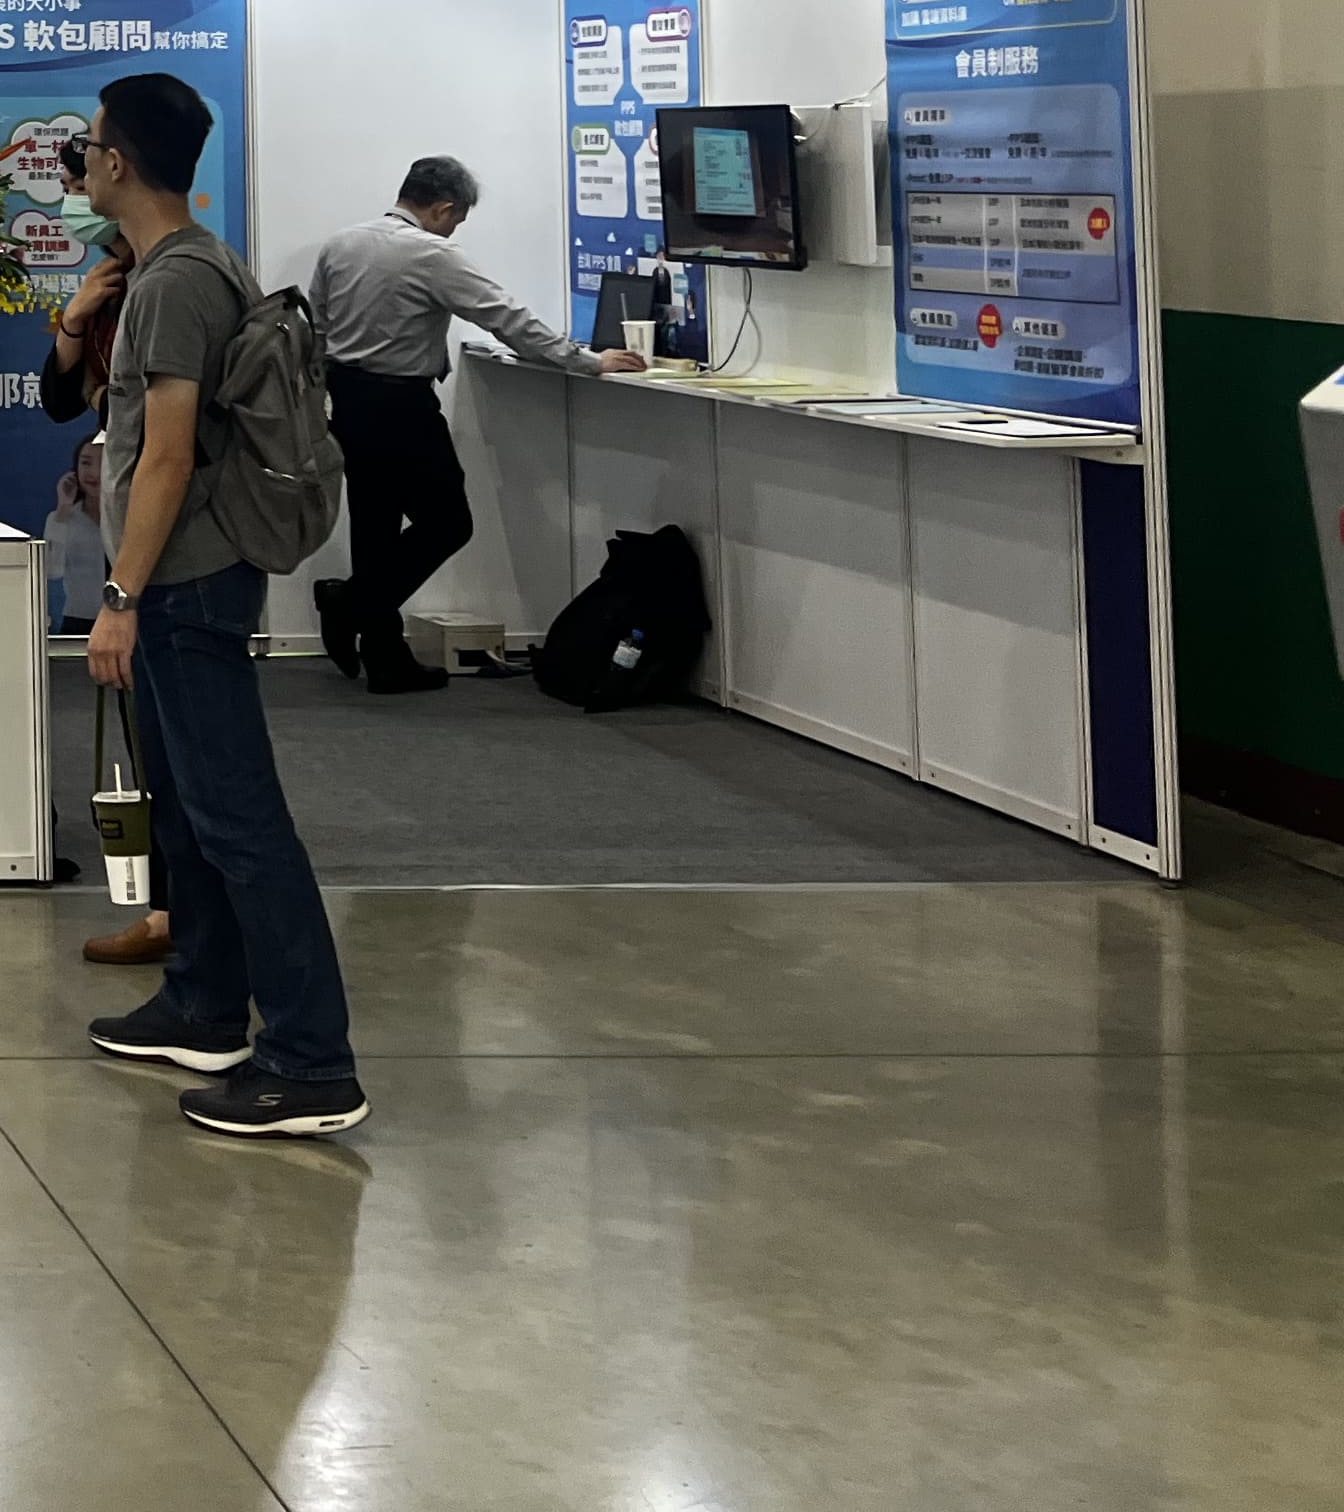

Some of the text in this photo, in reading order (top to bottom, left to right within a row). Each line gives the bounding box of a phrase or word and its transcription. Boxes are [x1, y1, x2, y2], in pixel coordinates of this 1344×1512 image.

[23, 20, 151, 51] 軟包顧問
[17, 156, 64, 171] 生物可
